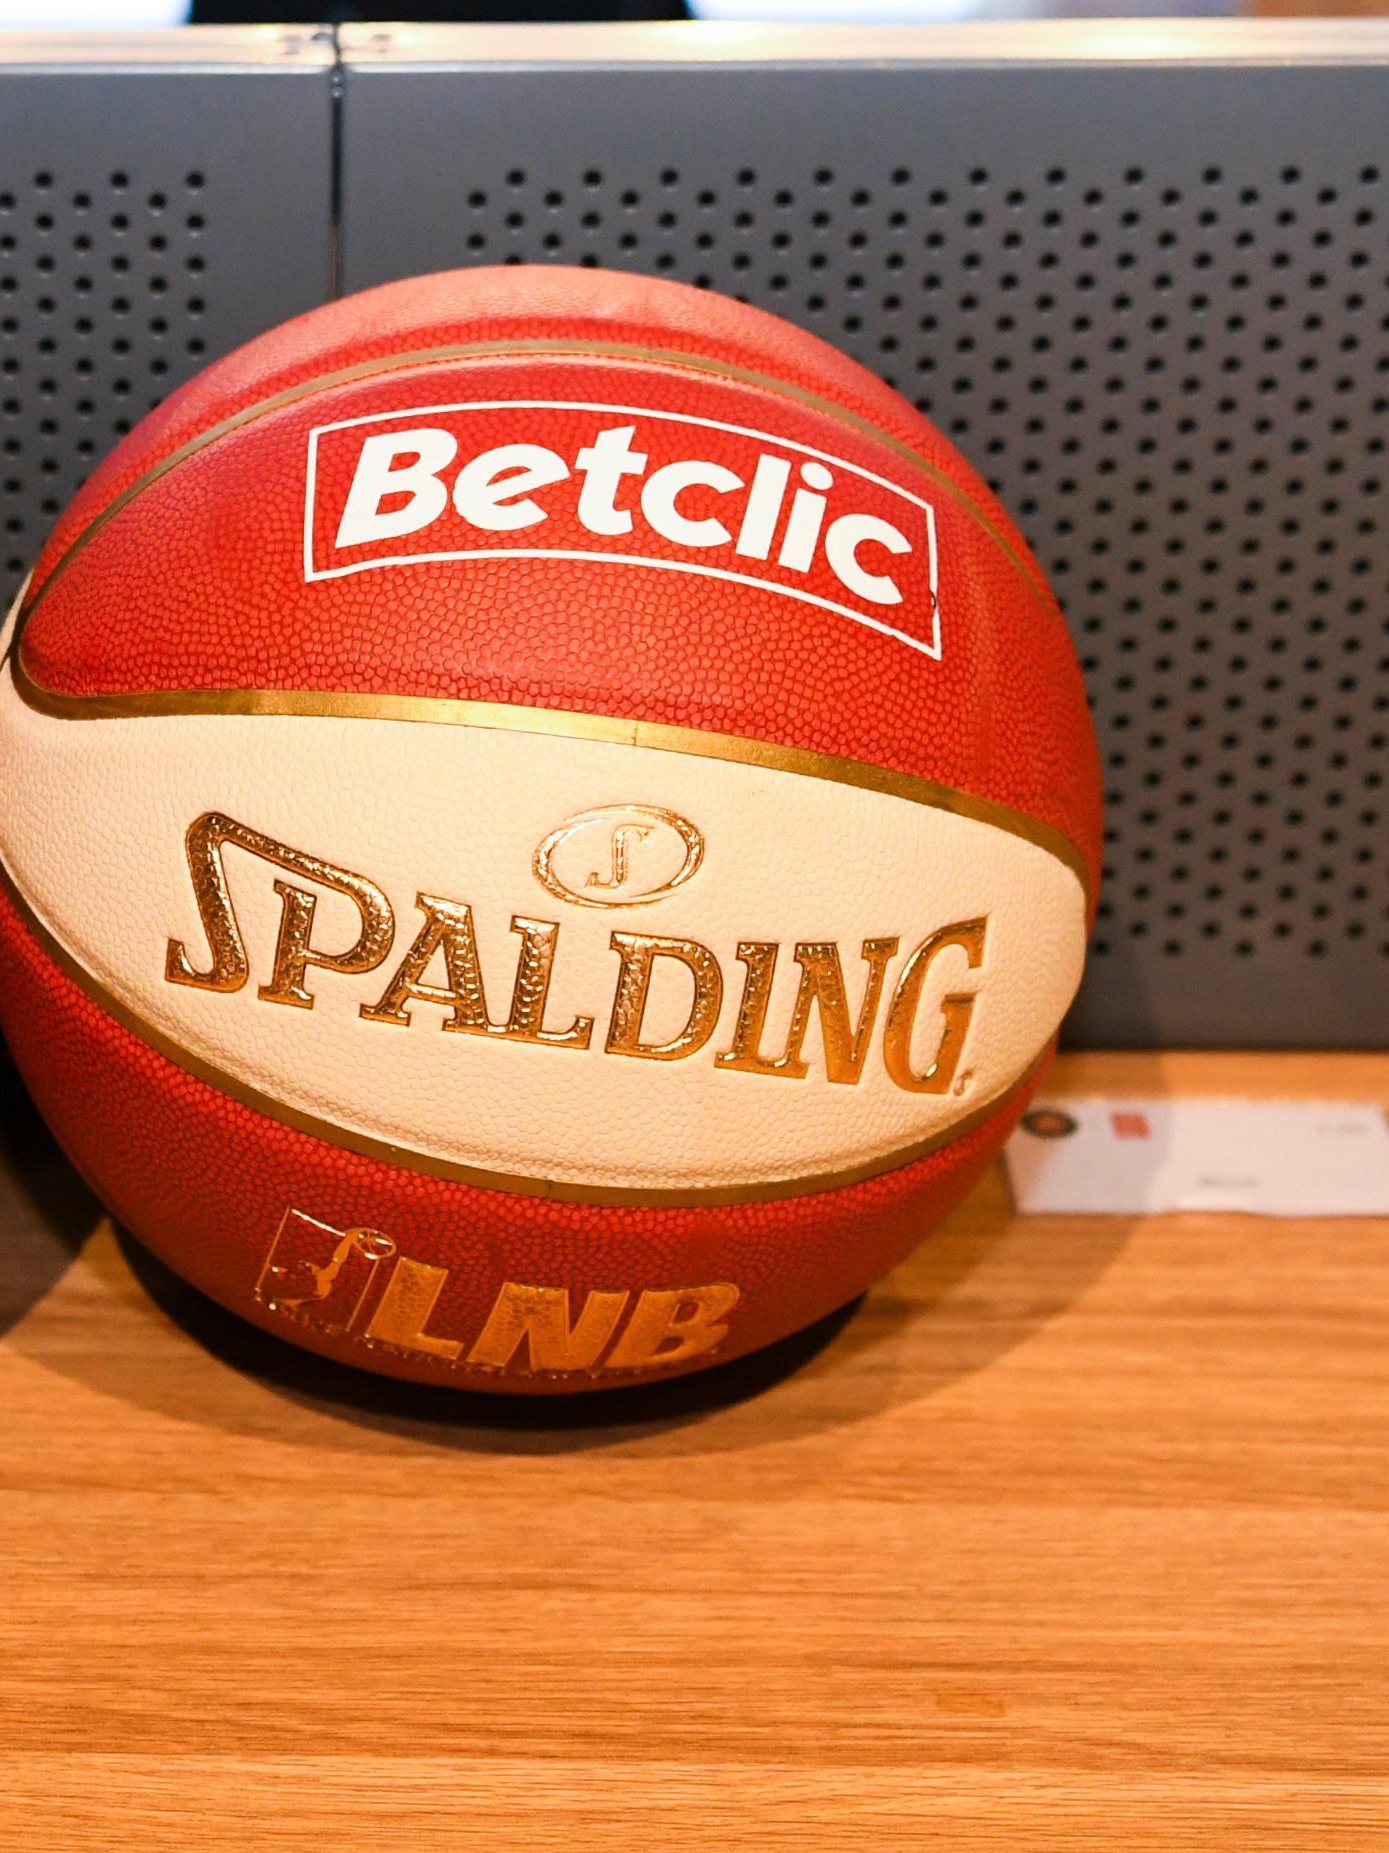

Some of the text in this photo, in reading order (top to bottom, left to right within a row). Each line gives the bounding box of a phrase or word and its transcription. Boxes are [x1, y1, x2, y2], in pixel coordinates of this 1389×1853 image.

[334, 425, 913, 605] Betclic
[163, 811, 991, 1096] SPALDING
[365, 1256, 740, 1373] LNB
